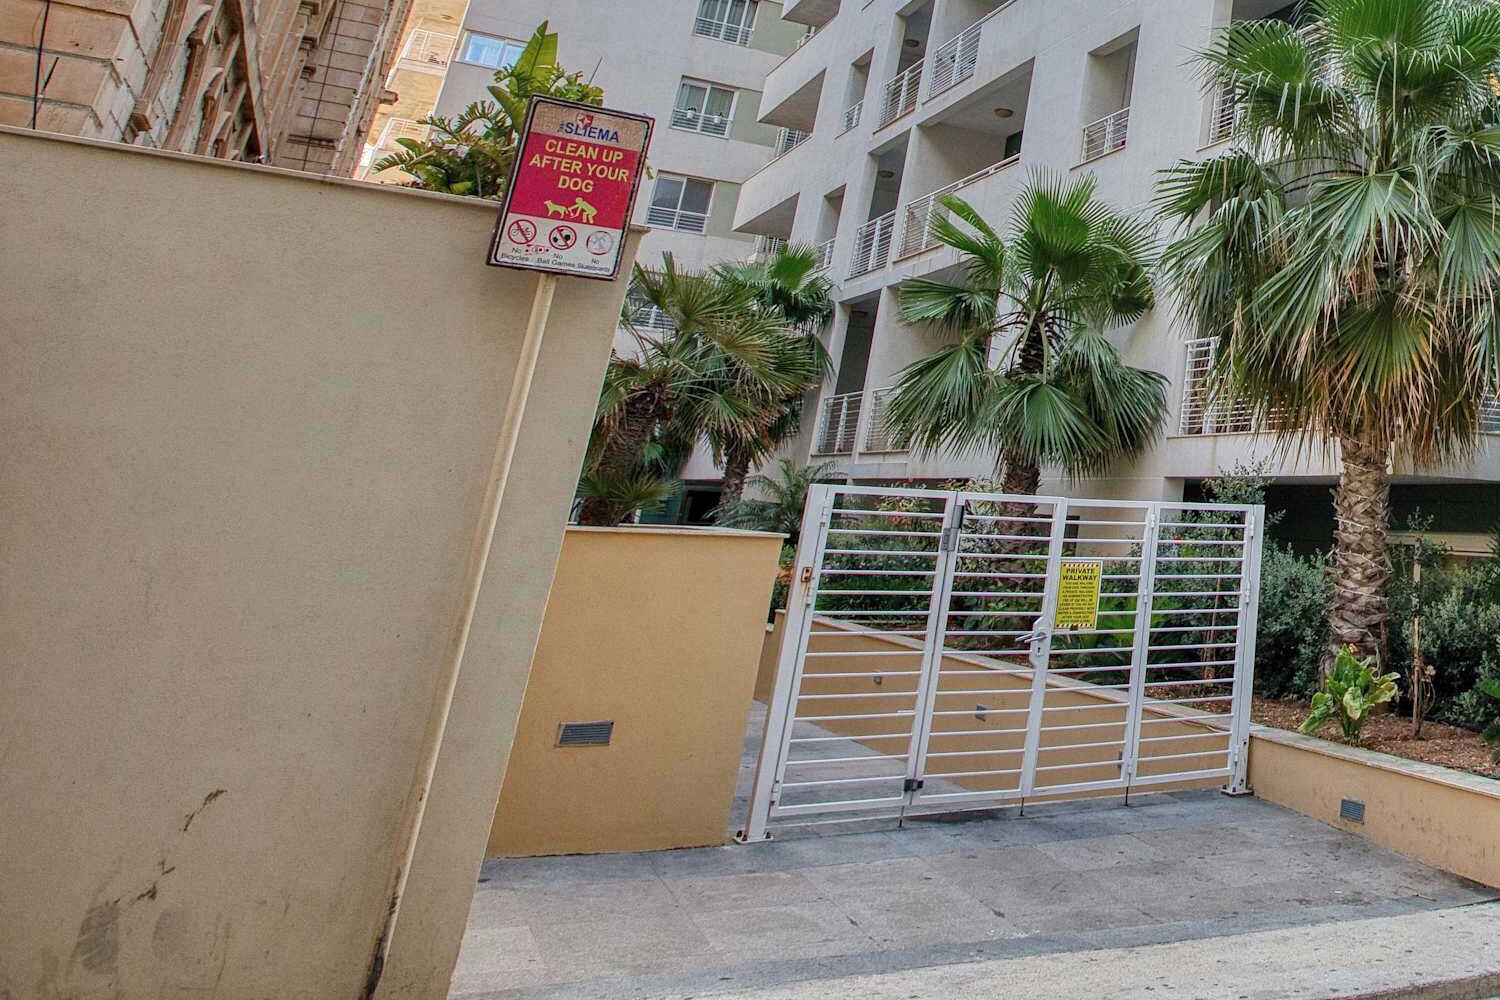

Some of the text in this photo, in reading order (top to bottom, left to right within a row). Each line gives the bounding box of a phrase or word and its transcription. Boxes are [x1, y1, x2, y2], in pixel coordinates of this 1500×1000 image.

[564, 122, 619, 143] SLIEMA
[545, 139, 623, 163] CLEAN UP
[529, 153, 629, 182] AFTER YOUR
[558, 175, 594, 193] DOG
